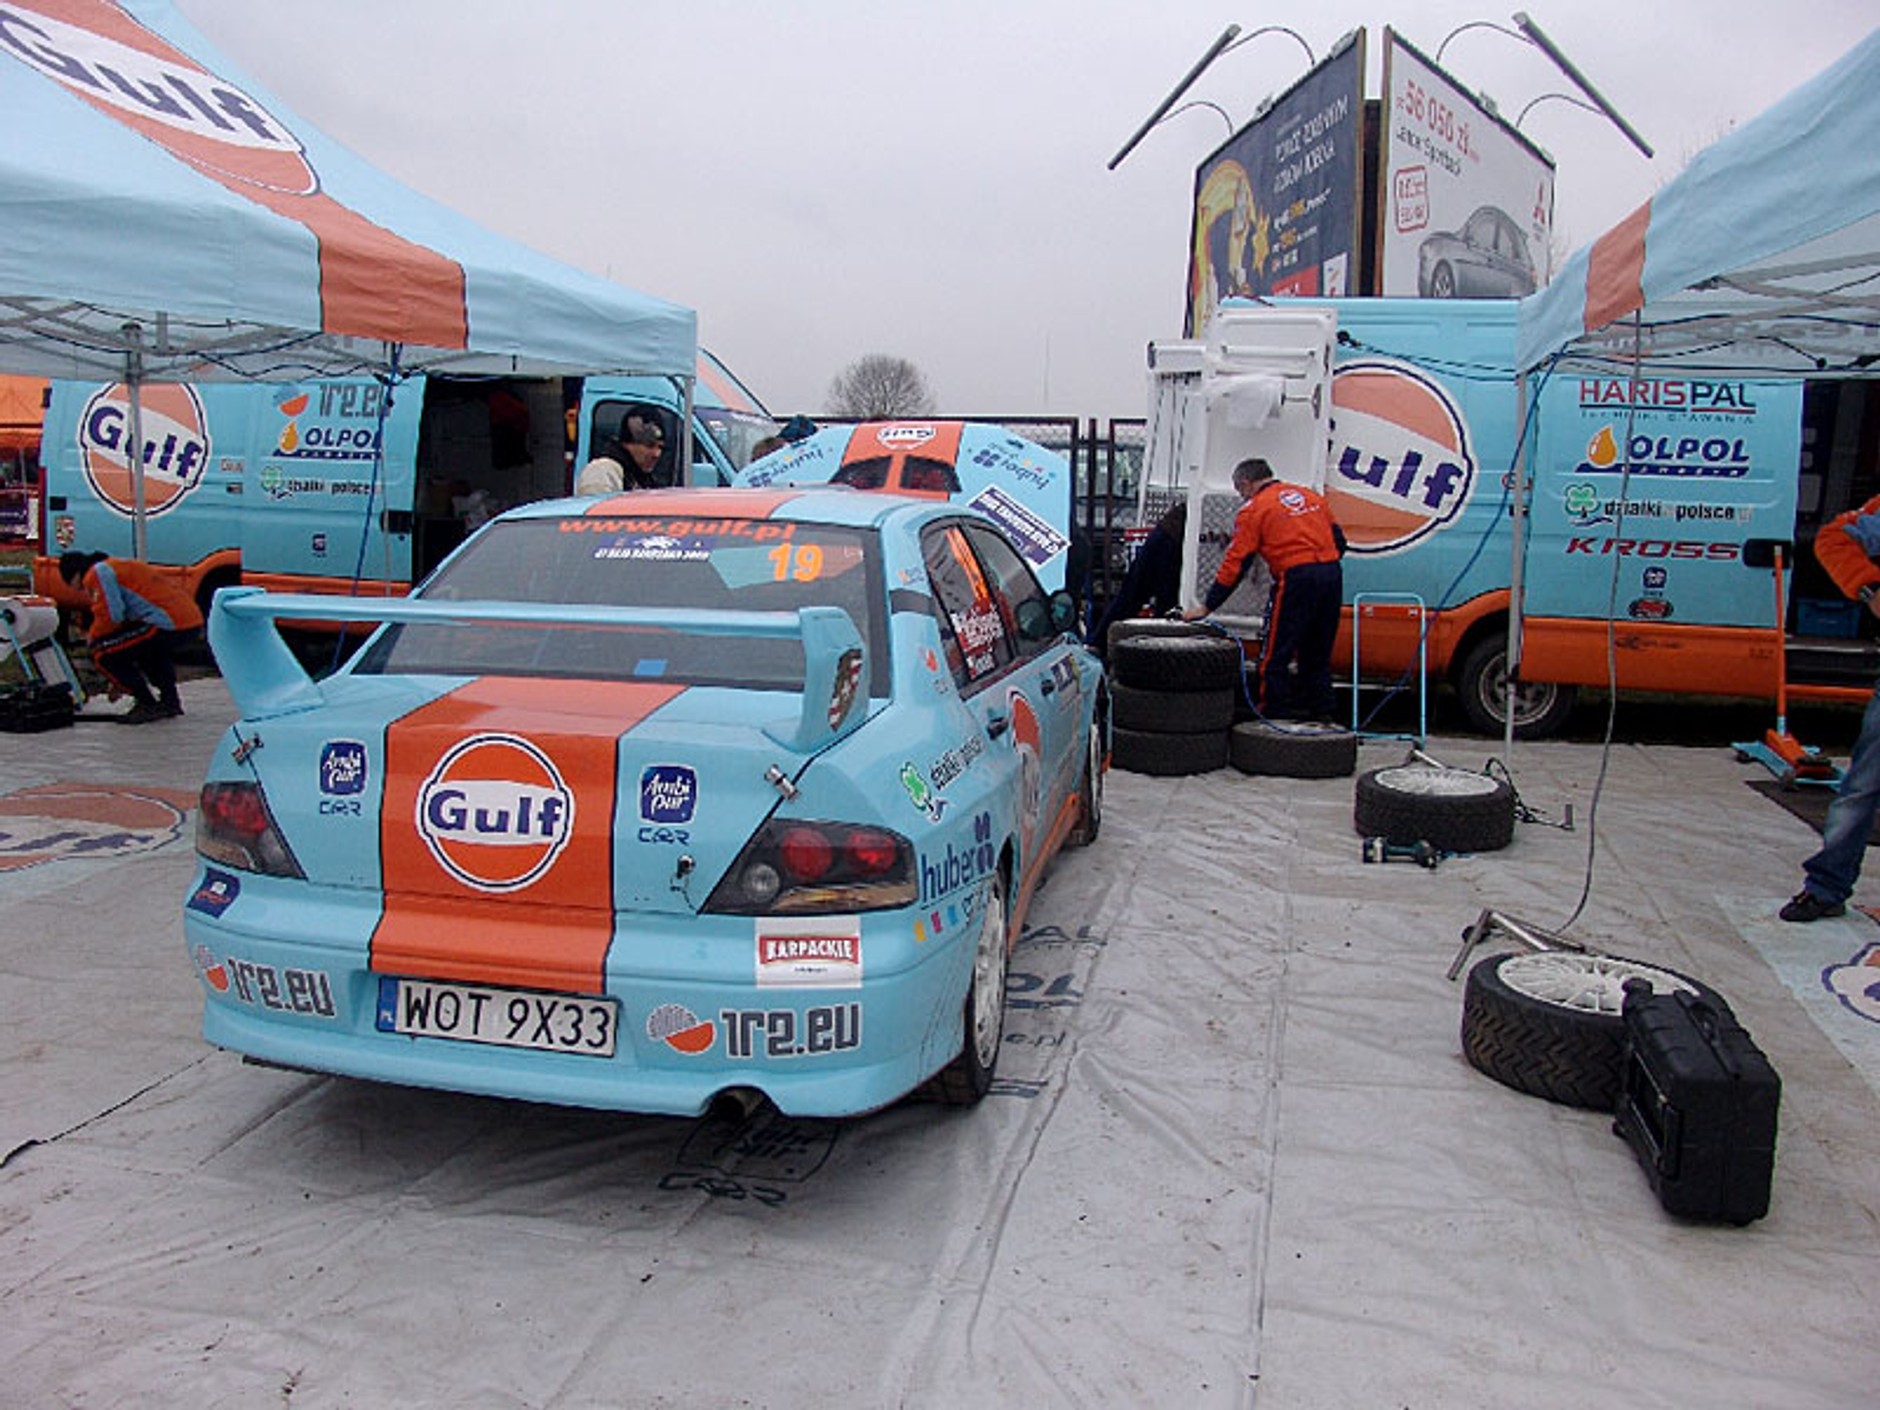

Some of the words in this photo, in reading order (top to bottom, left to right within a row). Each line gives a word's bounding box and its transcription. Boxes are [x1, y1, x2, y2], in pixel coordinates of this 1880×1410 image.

[0, 8, 281, 142] Gulf
[1579, 379, 1757, 407] HARISPAL
[1329, 418, 1464, 509] ulf
[1630, 435, 1750, 462] OLPOL
[558, 520, 796, 541] www.gulf.pl
[1566, 538, 1740, 560] KROSS
[769, 542, 823, 582] 19
[427, 788, 564, 837] Gulf
[920, 844, 977, 903] huber
[766, 939, 853, 961] KARPACKIE
[404, 985, 493, 1036] WOT
[506, 997, 611, 1049] 9X33
